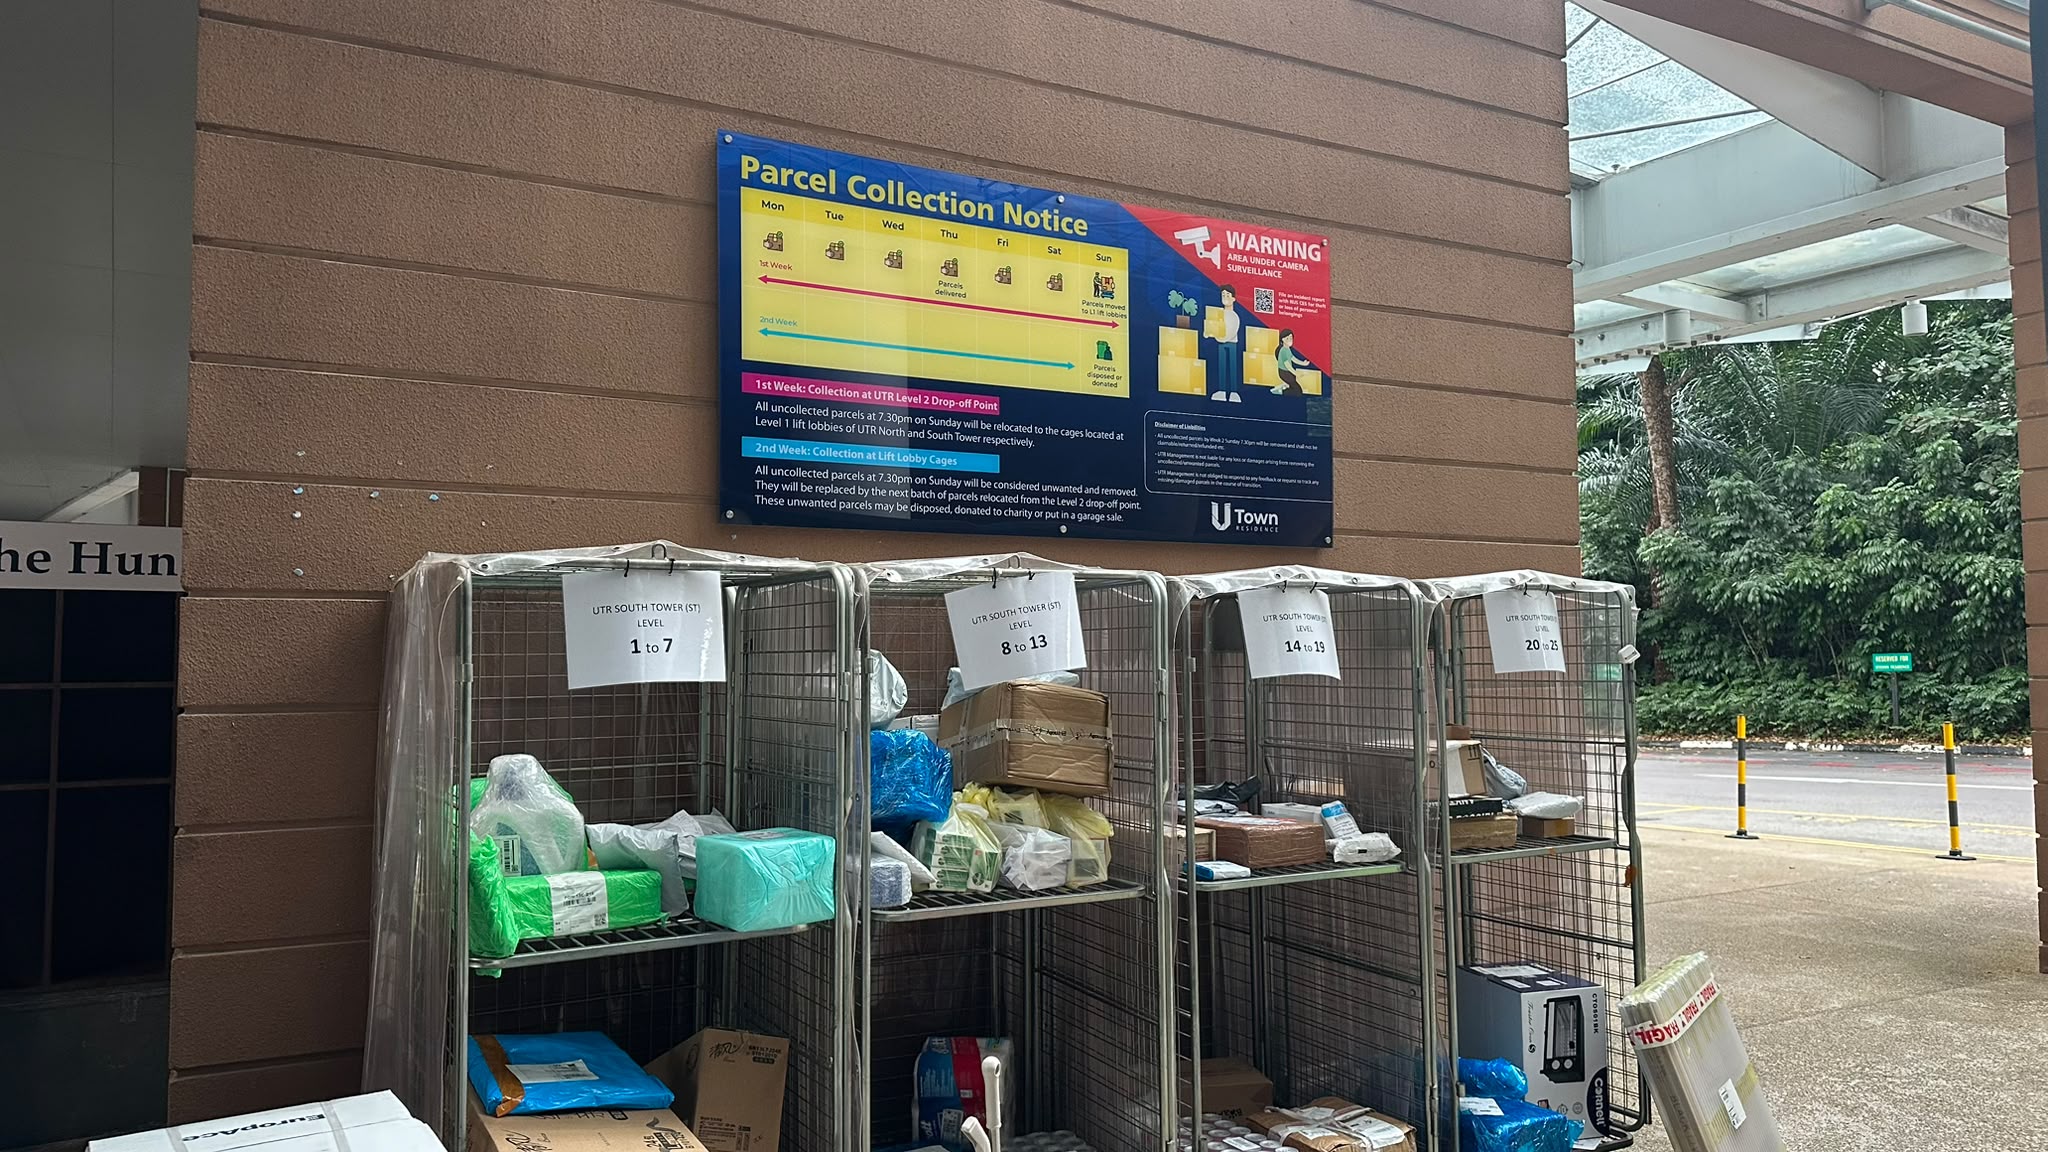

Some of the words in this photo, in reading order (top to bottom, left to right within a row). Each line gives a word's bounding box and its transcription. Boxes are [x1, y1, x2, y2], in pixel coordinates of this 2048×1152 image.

[742, 155, 835, 194] Parcel
[847, 176, 994, 220] Collection
[1004, 202, 1088, 236] Notice
[761, 200, 785, 212] Mon
[825, 211, 844, 222] Tue
[882, 220, 904, 232] Wed
[940, 229, 958, 240] Thu
[997, 237, 1009, 248] Fri
[1226, 230, 1321, 262] WARNING
[1047, 245, 1062, 256] Sat
[1096, 254, 1112, 262] Sun
[1227, 254, 1248, 263] AREA
[1250, 258, 1275, 267] UNDER
[1277, 261, 1308, 272] CAMERA
[759, 260, 769, 269] 1st
[770, 262, 793, 271] Week
[1227, 264, 1282, 278] SURVEILLANCE
[938, 280, 963, 290] Parcels
[934, 289, 966, 299] delivered
[1082, 300, 1104, 308] Parcels
[759, 316, 774, 325] 2nd
[776, 318, 798, 328] Week
[1087, 372, 1114, 380] disposed
[756, 380, 771, 390] 1st
[773, 382, 805, 393] Week:
[808, 385, 859, 398] Collection
[862, 391, 871, 399] at
[874, 391, 893, 401] UTR
[896, 393, 921, 403] Level
[924, 395, 929, 404] 2
[931, 396, 971, 409] Drop-off
[973, 400, 997, 410] Point
[755, 402, 768, 412] All
[771, 406, 828, 416] uncollected
[831, 410, 864, 421] parcels
[866, 412, 875, 420] at
[878, 412, 912, 425] 7.30pm
[928, 416, 961, 429] Sunday
[963, 419, 978, 428] will
[980, 420, 991, 430] be
[993, 423, 1032, 433] relocated
[1034, 425, 1043, 434] to
[1045, 426, 1058, 435] the
[1060, 428, 1083, 438] cages
[1085, 429, 1114, 439] located
[1116, 432, 1123, 440] at
[755, 417, 781, 428] Level
[784, 419, 788, 428] 1
[792, 420, 805, 429] lift
[808, 421, 843, 432] lobbies
[845, 424, 855, 433] of
[858, 425, 876, 434] UTR
[878, 426, 905, 437] North
[907, 429, 924, 438] and
[927, 430, 952, 440] South
[954, 432, 980, 442] Tower
[983, 436, 1034, 448] respectively.
[756, 443, 776, 453] 2nd
[778, 445, 810, 456] Week:
[812, 447, 864, 459] Collection
[866, 452, 876, 460] at
[878, 452, 894, 461] Lift
[897, 453, 926, 465] Lobby
[929, 455, 956, 467] Cages
[755, 466, 767, 475] All
[771, 469, 828, 479] uncollected
[831, 471, 864, 482] parcels
[866, 473, 875, 481] at
[878, 473, 912, 485] 7.30pm
[929, 476, 961, 488] Sunday
[963, 478, 978, 487] will
[980, 479, 991, 488] be
[993, 481, 1039, 490] considered
[1041, 483, 1082, 493] unwanted
[1084, 485, 1099, 494] and
[1101, 486, 1137, 496] removed.
[755, 481, 779, 492] They
[781, 483, 798, 492] will
[800, 484, 812, 493] be
[815, 485, 855, 496] replaced
[858, 486, 869, 497] by
[871, 488, 886, 496] the
[888, 488, 908, 498] next
[910, 489, 935, 499] batch
[937, 491, 946, 500] of
[948, 492, 978, 503] parcels
[980, 494, 1018, 503] relocated
[1020, 495, 1039, 504] from
[1041, 496, 1055, 505] the
[1057, 497, 1077, 506] Level
[1086, 499, 1118, 510] drop-off
[1119, 500, 1140, 511] point.
[755, 496, 784, 506] These
[787, 498, 836, 508] unwanted
[839, 500, 872, 511] parcels
[874, 503, 894, 512] may
[896, 502, 908, 512] be
[910, 503, 952, 515] disposed,
[954, 505, 990, 515] donated
[993, 507, 1002, 516] to
[1003, 508, 1032, 519] charity
[1045, 510, 1058, 520] put
[1061, 510, 1068, 519] in
[1077, 513, 1104, 522] garage
[1106, 513, 1123, 522] sale.
[1234, 509, 1278, 526] Town
[68, 541, 178, 576] Hun
[593, 606, 612, 615] UTR
[615, 604, 648, 613] SOUTH
[650, 604, 683, 612] TOWER
[685, 604, 701, 613] (ST)
[972, 615, 988, 625] UTR
[989, 608, 1016, 620] SOUTH
[1018, 604, 1046, 615] TOWER
[1048, 601, 1061, 612] (ST)
[637, 619, 664, 628] LEVEL
[1009, 620, 1032, 631] LEVEL
[630, 639, 641, 654] 1
[646, 642, 659, 653] to
[663, 638, 673, 652] 7
[1001, 641, 1012, 655] 8
[1015, 643, 1026, 653] to
[1030, 634, 1048, 650] 13
[1285, 640, 1301, 652] 14
[1304, 644, 1312, 652] to
[1314, 641, 1325, 653] 19
[1526, 640, 1540, 650] 20
[182, 1114, 326, 1142] EuropAce
